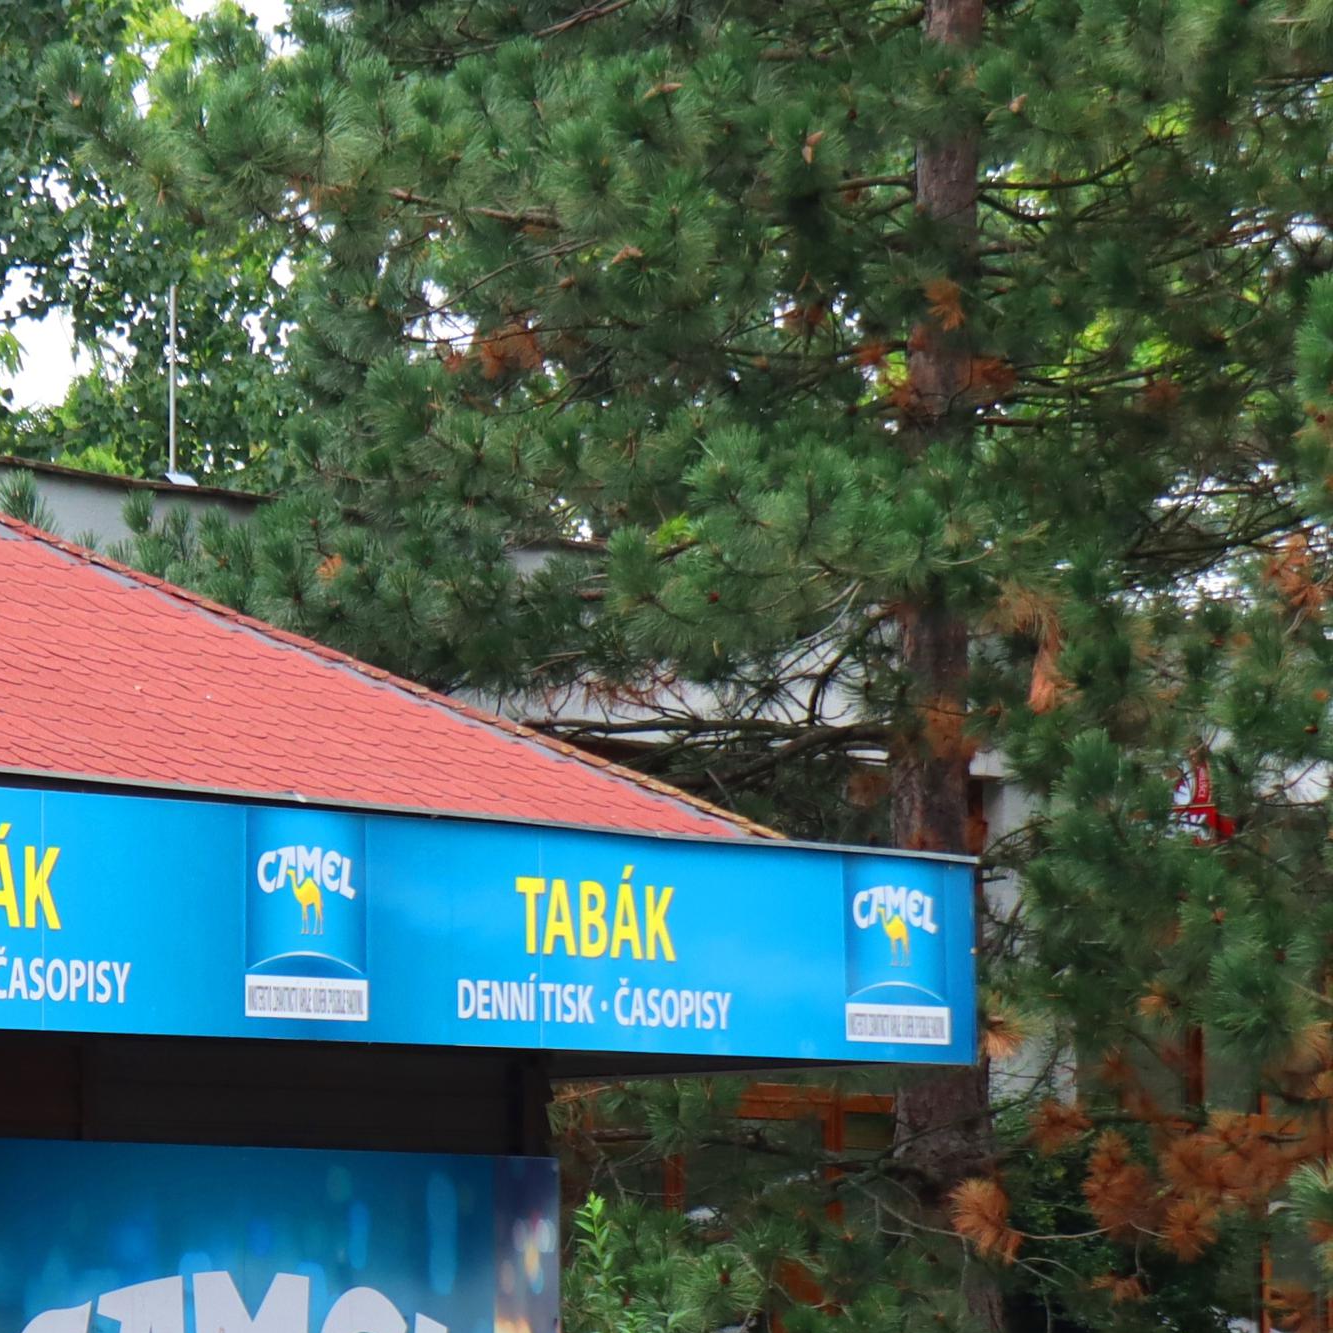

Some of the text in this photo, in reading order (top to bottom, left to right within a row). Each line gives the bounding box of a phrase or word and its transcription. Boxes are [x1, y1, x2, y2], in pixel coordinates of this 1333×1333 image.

[257, 845, 356, 900] CAMEL
[515, 865, 676, 962] TABÁK
[852, 884, 937, 934] CAMEL
[457, 973, 731, 1031] DENNÍ TISK ČASOPISY
